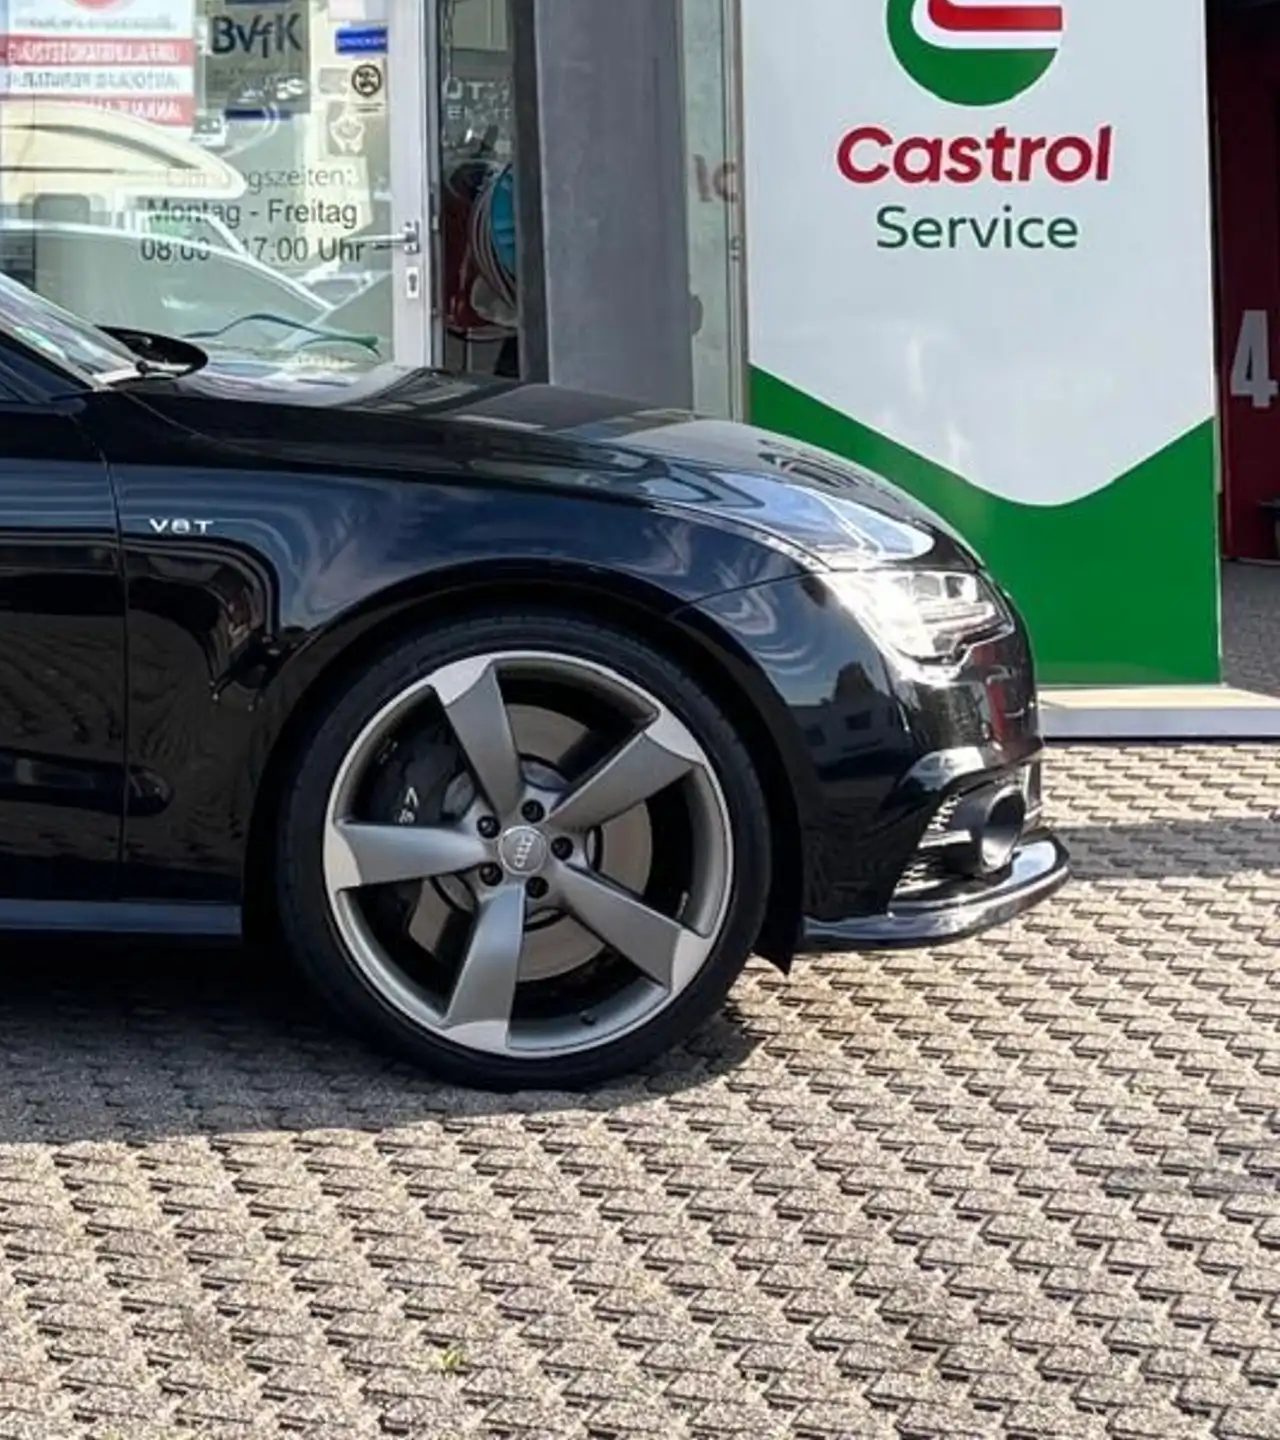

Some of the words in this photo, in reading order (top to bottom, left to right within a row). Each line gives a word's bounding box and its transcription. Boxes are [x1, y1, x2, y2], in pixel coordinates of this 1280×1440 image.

[836, 125, 1112, 184] Castrol
[268, 198, 358, 229] Freitag
[876, 204, 1079, 249] Service
[318, 237, 366, 262] Uhr
[1230, 309, 1278, 408] 4
